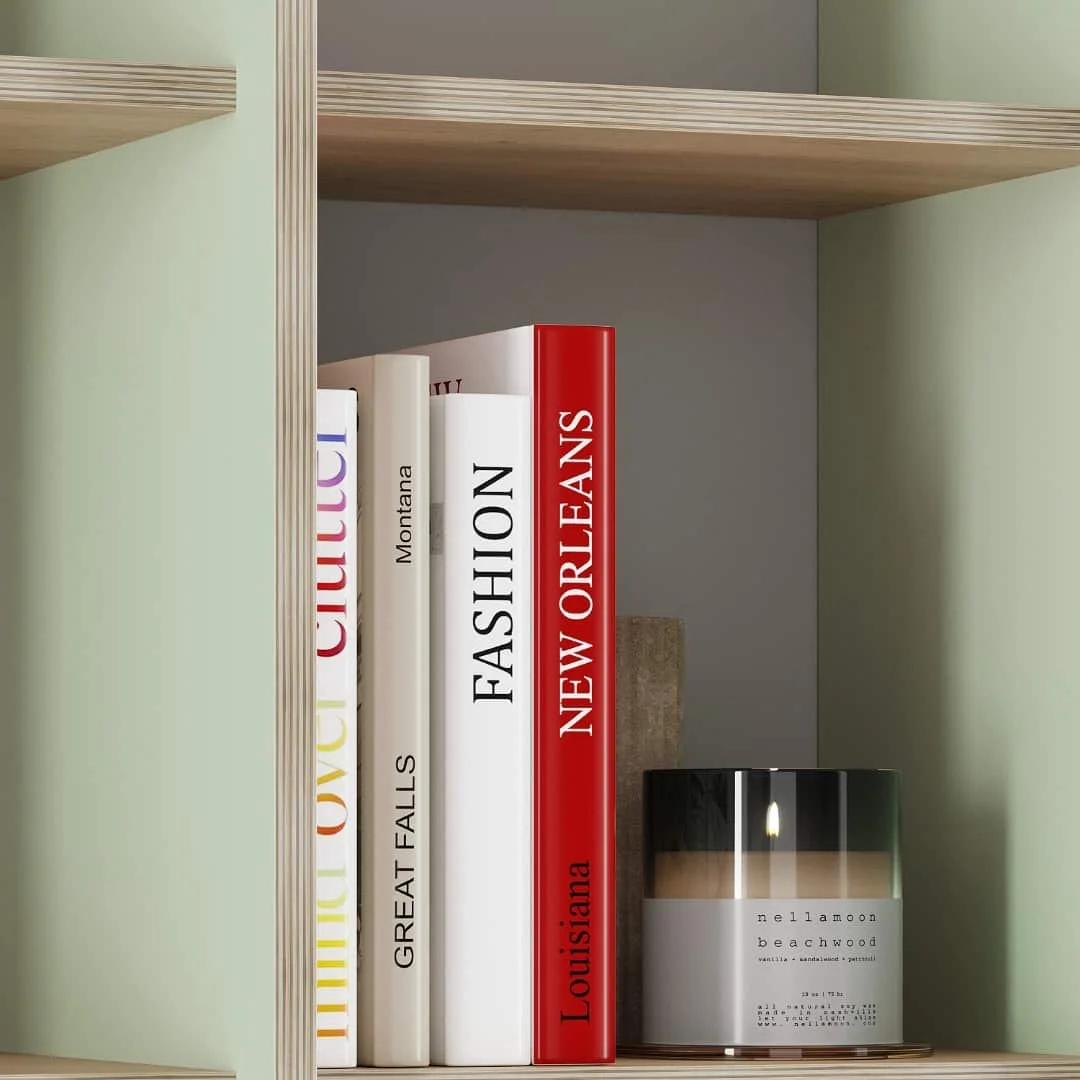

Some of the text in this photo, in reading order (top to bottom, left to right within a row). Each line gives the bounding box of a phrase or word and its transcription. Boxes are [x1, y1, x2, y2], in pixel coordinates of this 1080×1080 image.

[395, 464, 412, 564] Montana
[472, 462, 513, 704] FASHION
[558, 409, 593, 738] NEW ORLEANS
[394, 754, 416, 969] GREAT FALLS
[559, 860, 591, 1026] Louisiana
[757, 911, 876, 922] nellamoon
[757, 937, 876, 948] beachwood
